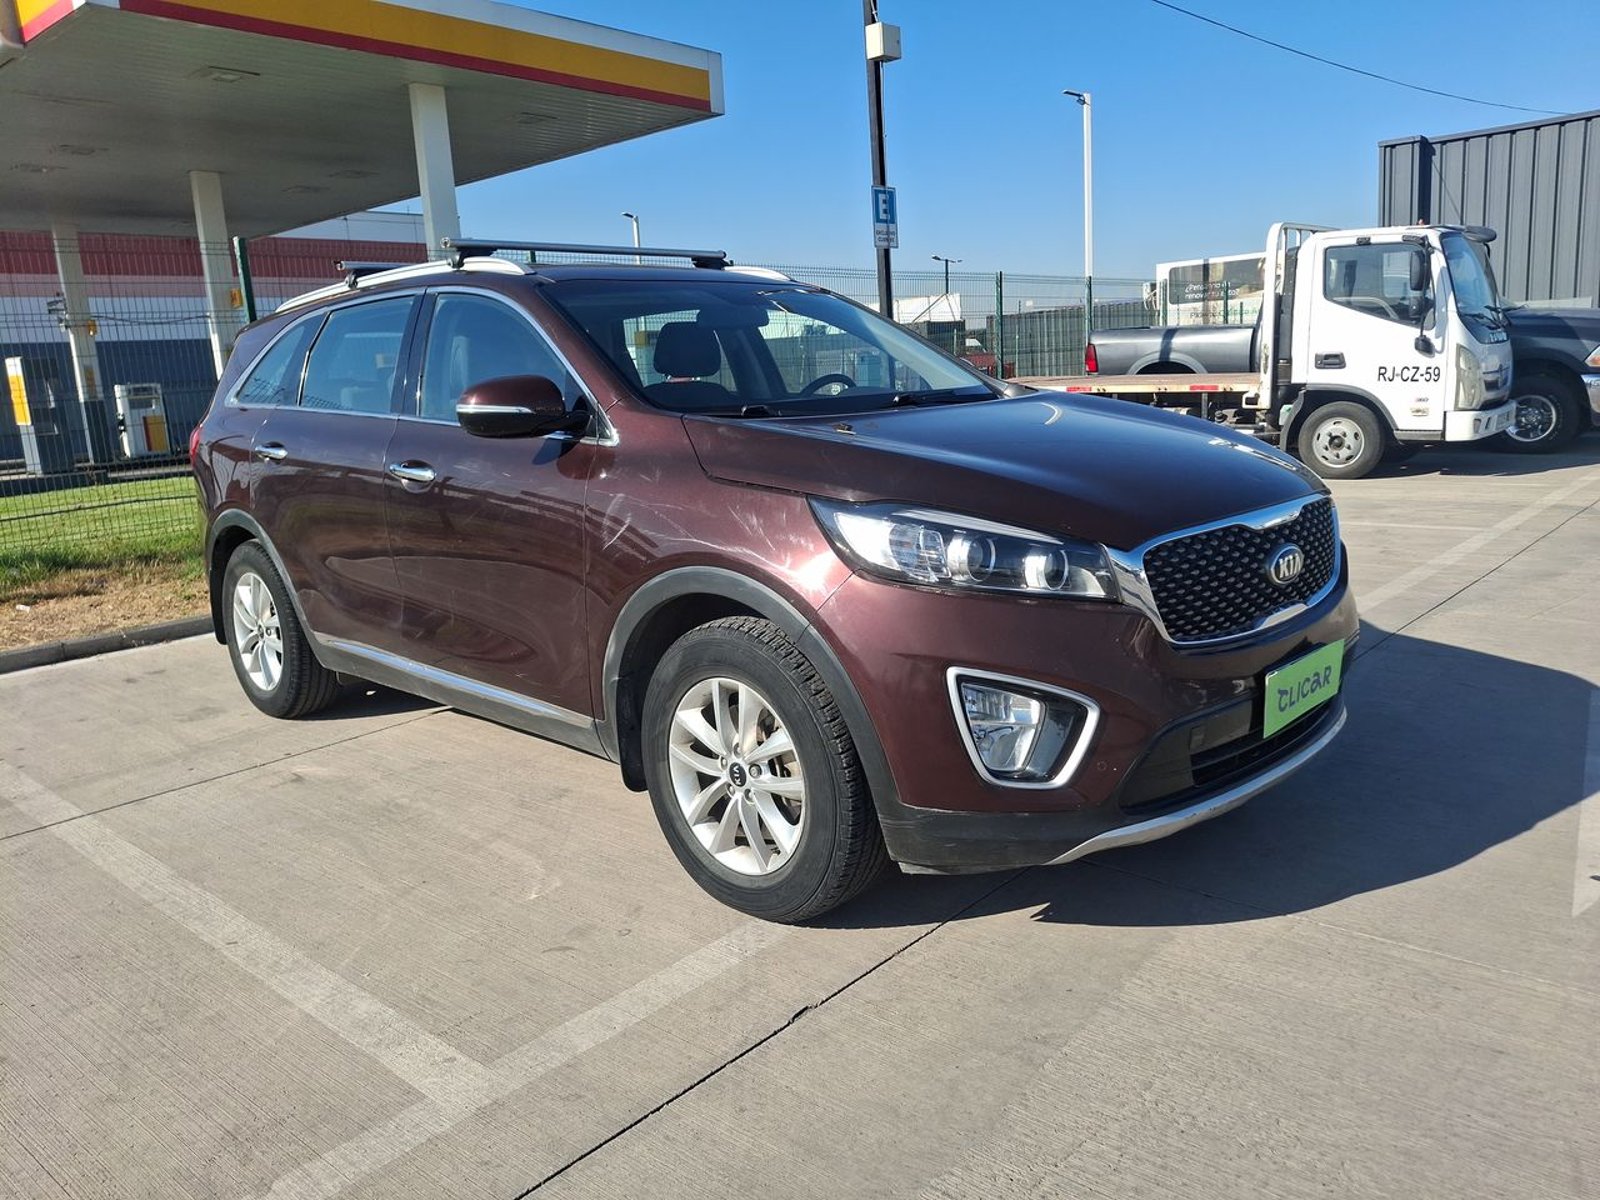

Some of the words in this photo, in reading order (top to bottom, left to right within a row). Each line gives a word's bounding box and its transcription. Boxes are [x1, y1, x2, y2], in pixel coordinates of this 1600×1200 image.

[879, 193, 890, 220] E
[1377, 366, 1441, 382] RJ-CZ-59
[1279, 553, 1301, 578] KIA
